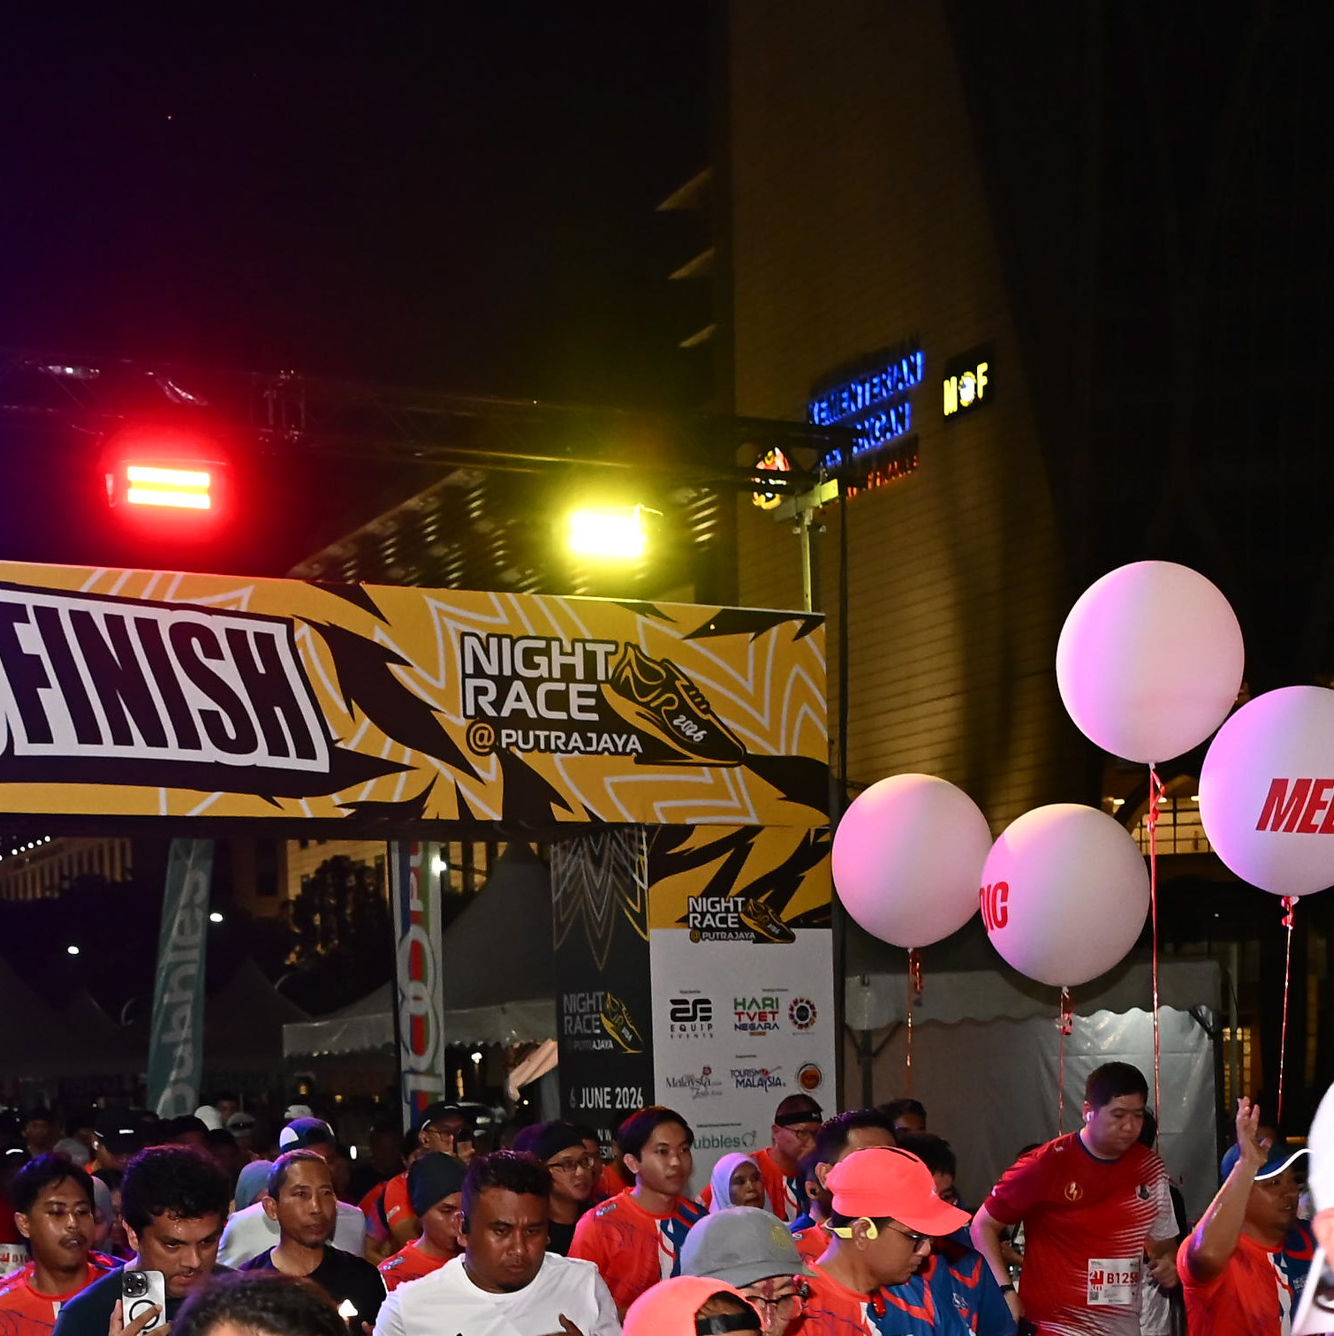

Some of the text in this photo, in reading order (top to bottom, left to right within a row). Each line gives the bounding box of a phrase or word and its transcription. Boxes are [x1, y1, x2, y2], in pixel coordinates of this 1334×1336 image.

[464, 635, 616, 682] NIGHT
[464, 677, 600, 721] RACE
[672, 713, 706, 745] 2026
[501, 729, 643, 754] PUTRAJAYA
[688, 897, 745, 913] NIGHT
[689, 913, 740, 928] RACE
[702, 931, 756, 941] PUTRAJAYA
[563, 992, 605, 1014] NIGHT
[733, 997, 779, 1010] HARI
[564, 1014, 601, 1035] RACE
[734, 1011, 779, 1022] TVET
[670, 1024, 713, 1032] EQUIP
[734, 1023, 780, 1031] NEGARA
[731, 1068, 763, 1079] TOURISM
[736, 1076, 782, 1091] MALAYSIA
[580, 1087, 612, 1110] JUNE
[615, 1087, 644, 1110] 2026
[693, 1133, 741, 1150] ubbles
